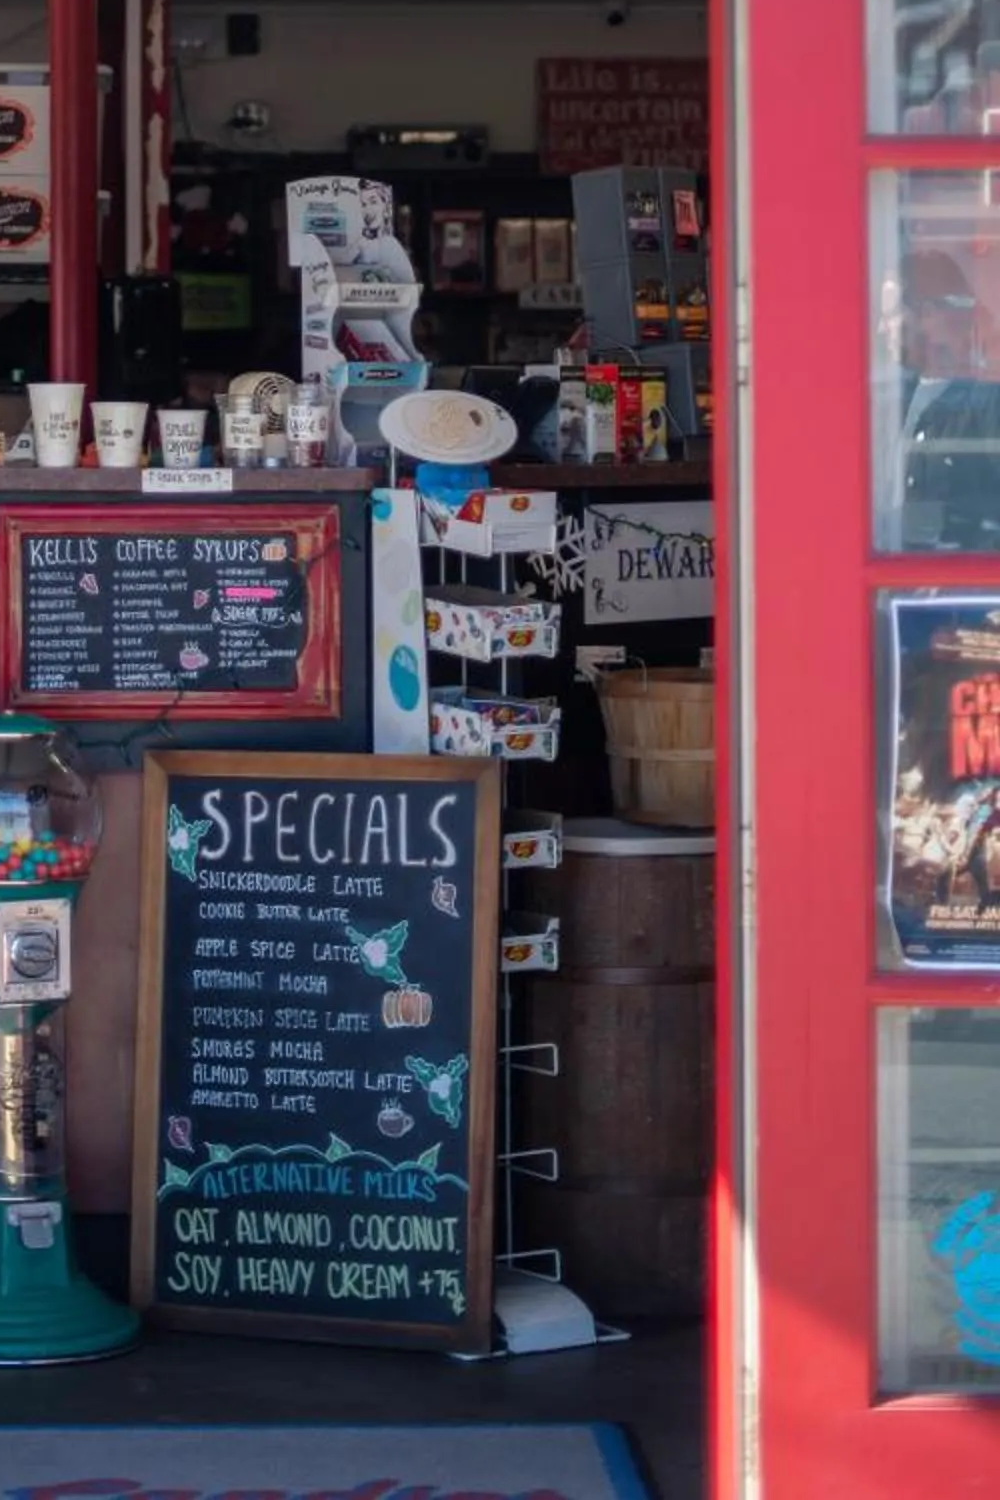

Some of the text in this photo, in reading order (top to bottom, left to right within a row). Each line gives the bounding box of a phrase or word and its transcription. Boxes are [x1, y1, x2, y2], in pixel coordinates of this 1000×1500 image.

[116, 539, 178, 562] COFFEE
[193, 538, 261, 562] SYRUPS
[200, 788, 459, 867] SPECIALS
[198, 869, 384, 898] SNICKERDOODLE LATTE
[199, 902, 351, 923] COOKIE BUTTER LATTE
[195, 939, 361, 964] APPLE SPICE LATTE
[192, 969, 328, 996] PEPPERMINT MOCHA
[192, 1006, 371, 1033] PUMPKIN SPICE LATTE
[270, 1040, 324, 1062] MOCHA
[193, 1063, 413, 1094] ALMOND BUTTERSCOTCH LATTE
[191, 1088, 317, 1114] AMARETTO LATTE
[202, 1162, 438, 1202] ALTERNATIVE MILKS
[237, 1257, 316, 1298] HEAVY
[327, 1261, 412, 1300] CREAM
